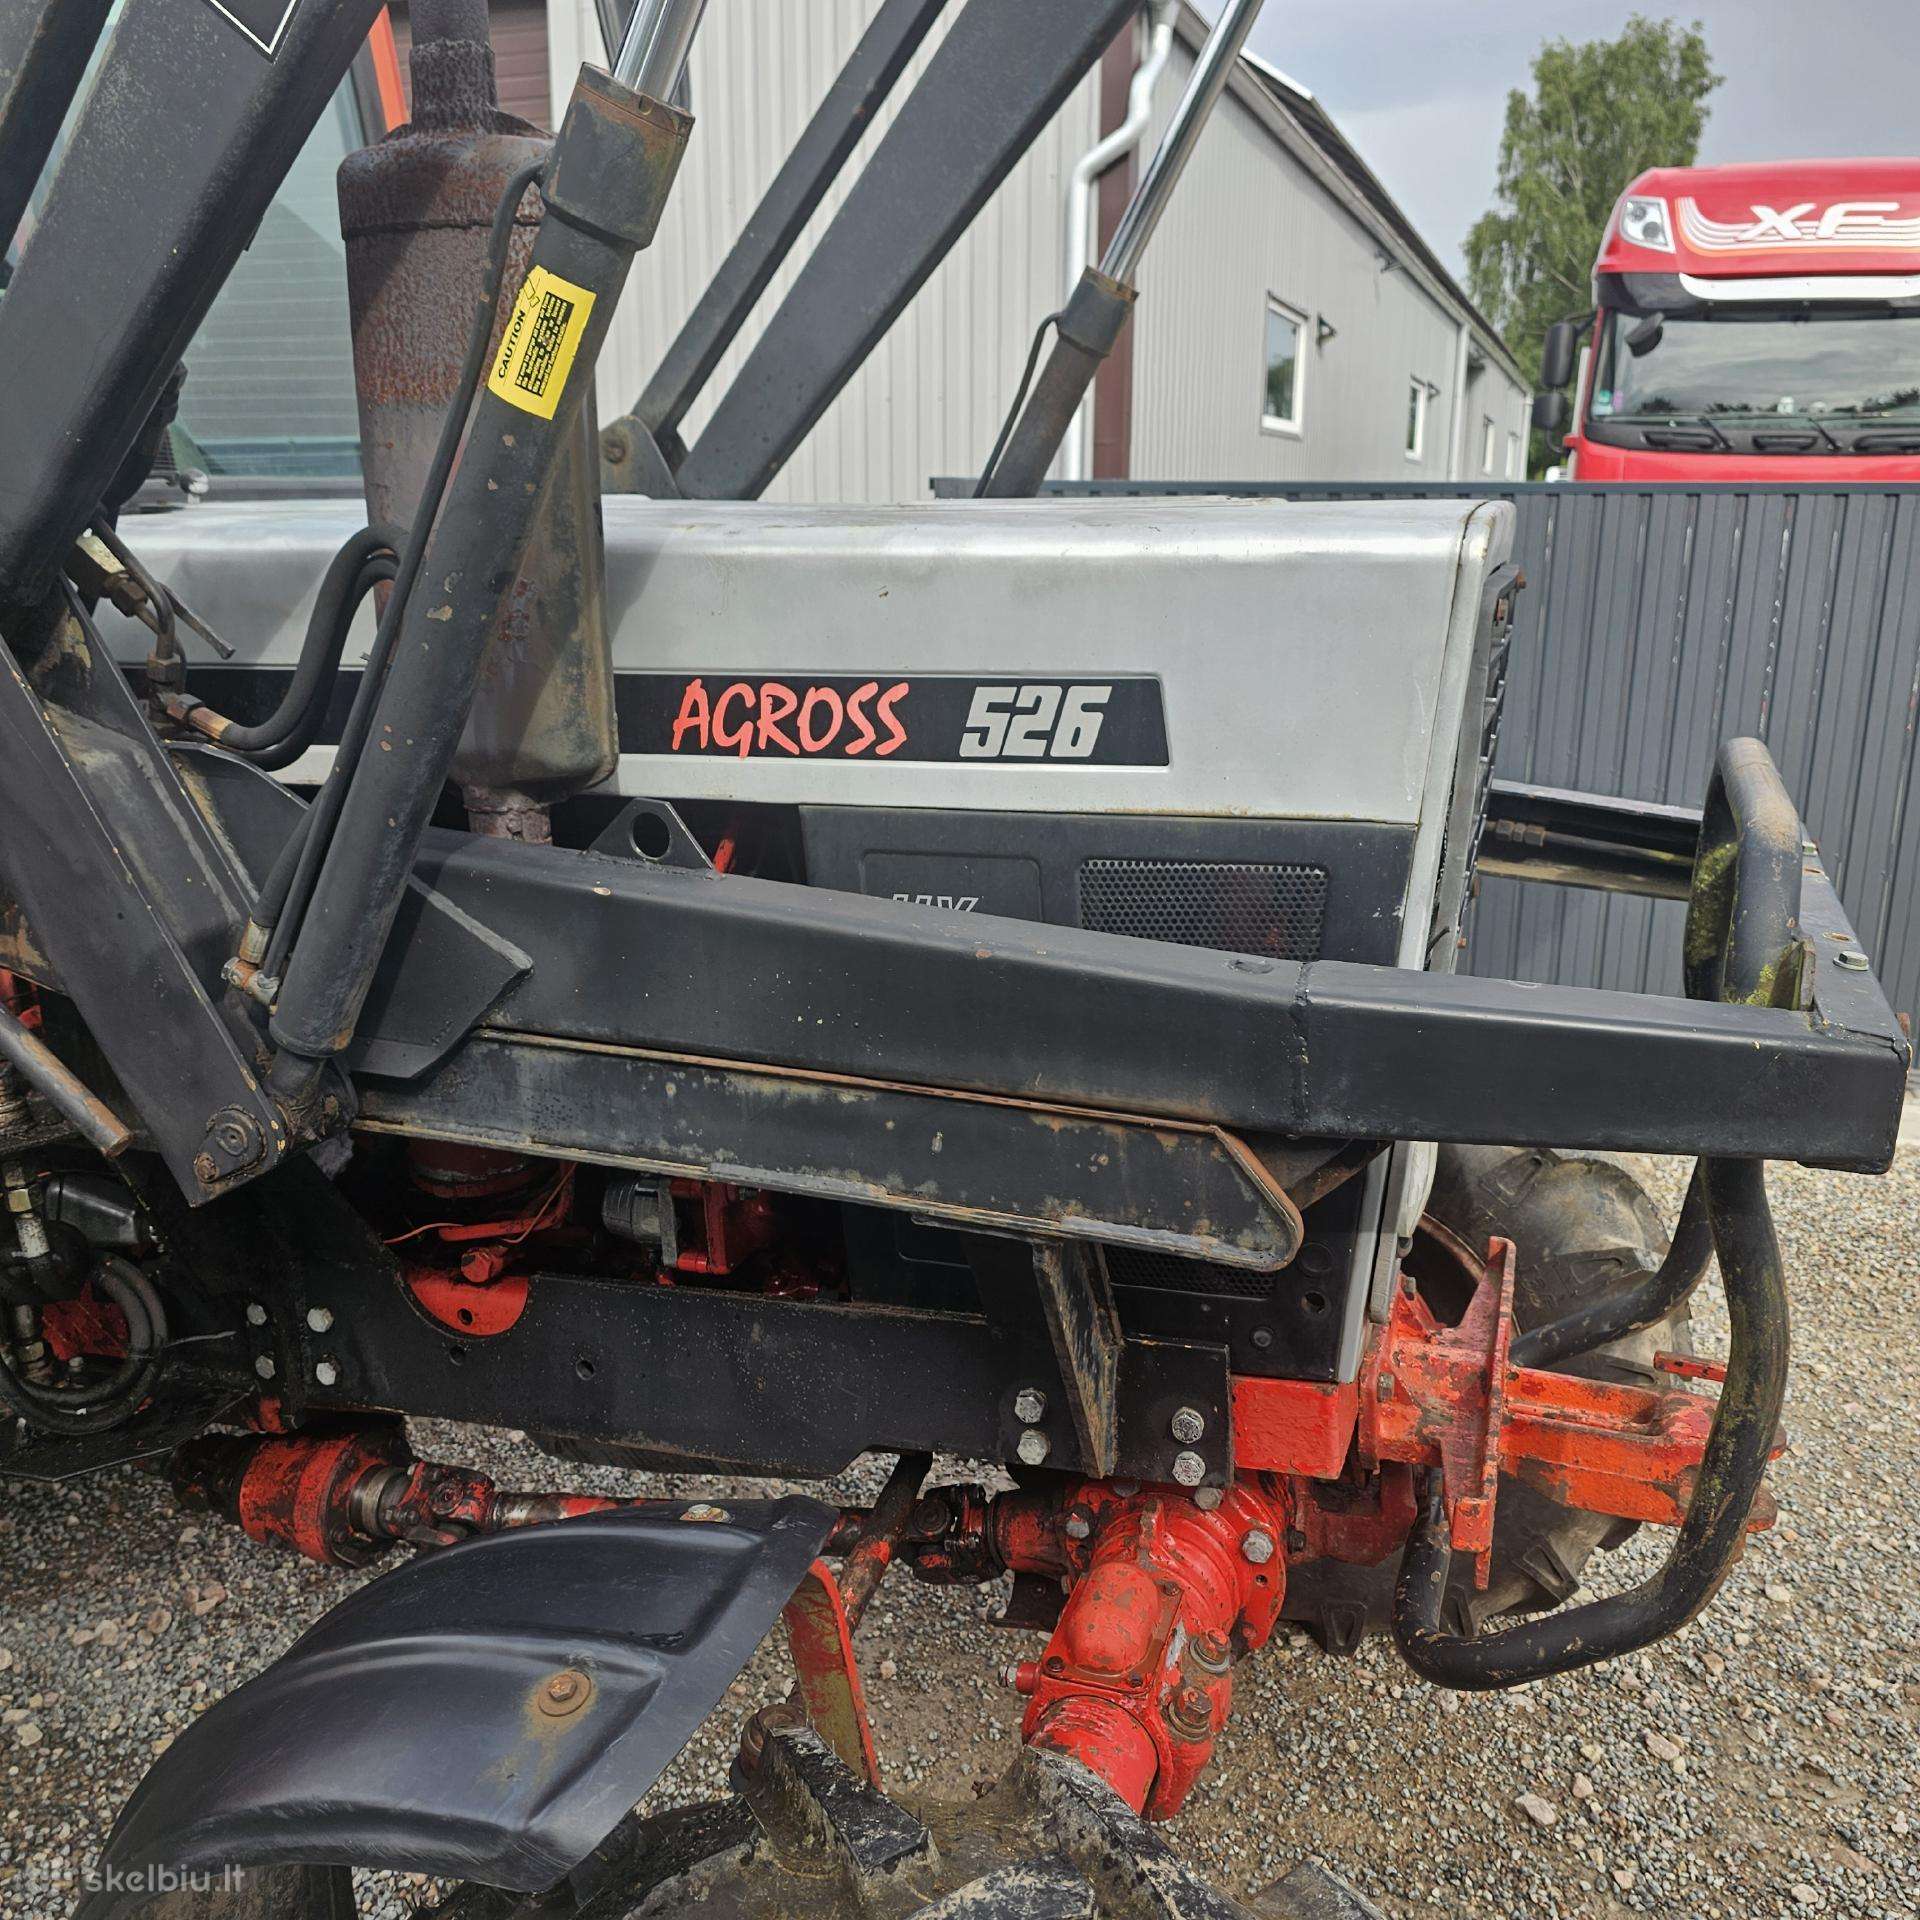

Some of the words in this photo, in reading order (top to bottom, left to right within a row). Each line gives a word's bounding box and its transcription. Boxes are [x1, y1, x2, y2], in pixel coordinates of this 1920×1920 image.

[1735, 202, 1901, 242] XF
[498, 311, 526, 379] CAUTION
[672, 678, 910, 758] AGROSS
[959, 685, 1112, 757] 526
